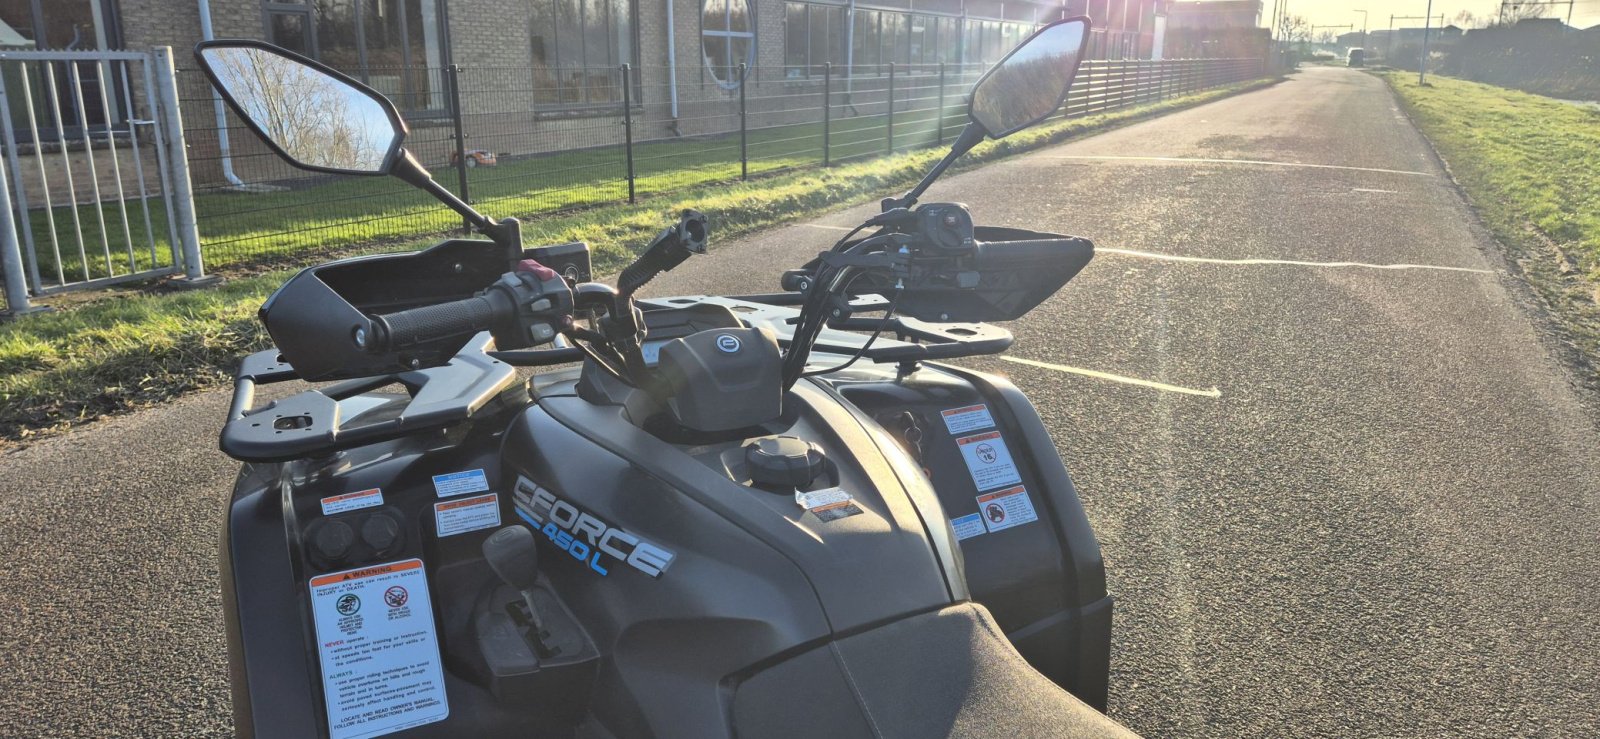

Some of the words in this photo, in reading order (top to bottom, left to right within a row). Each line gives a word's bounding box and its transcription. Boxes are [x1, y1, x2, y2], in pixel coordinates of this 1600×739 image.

[513, 474, 674, 577] CFORCE
[542, 522, 590, 561] 450
[353, 566, 391, 578] WARNING
[325, 640, 344, 648] NEVER
[334, 721, 356, 729] FOLLOW
